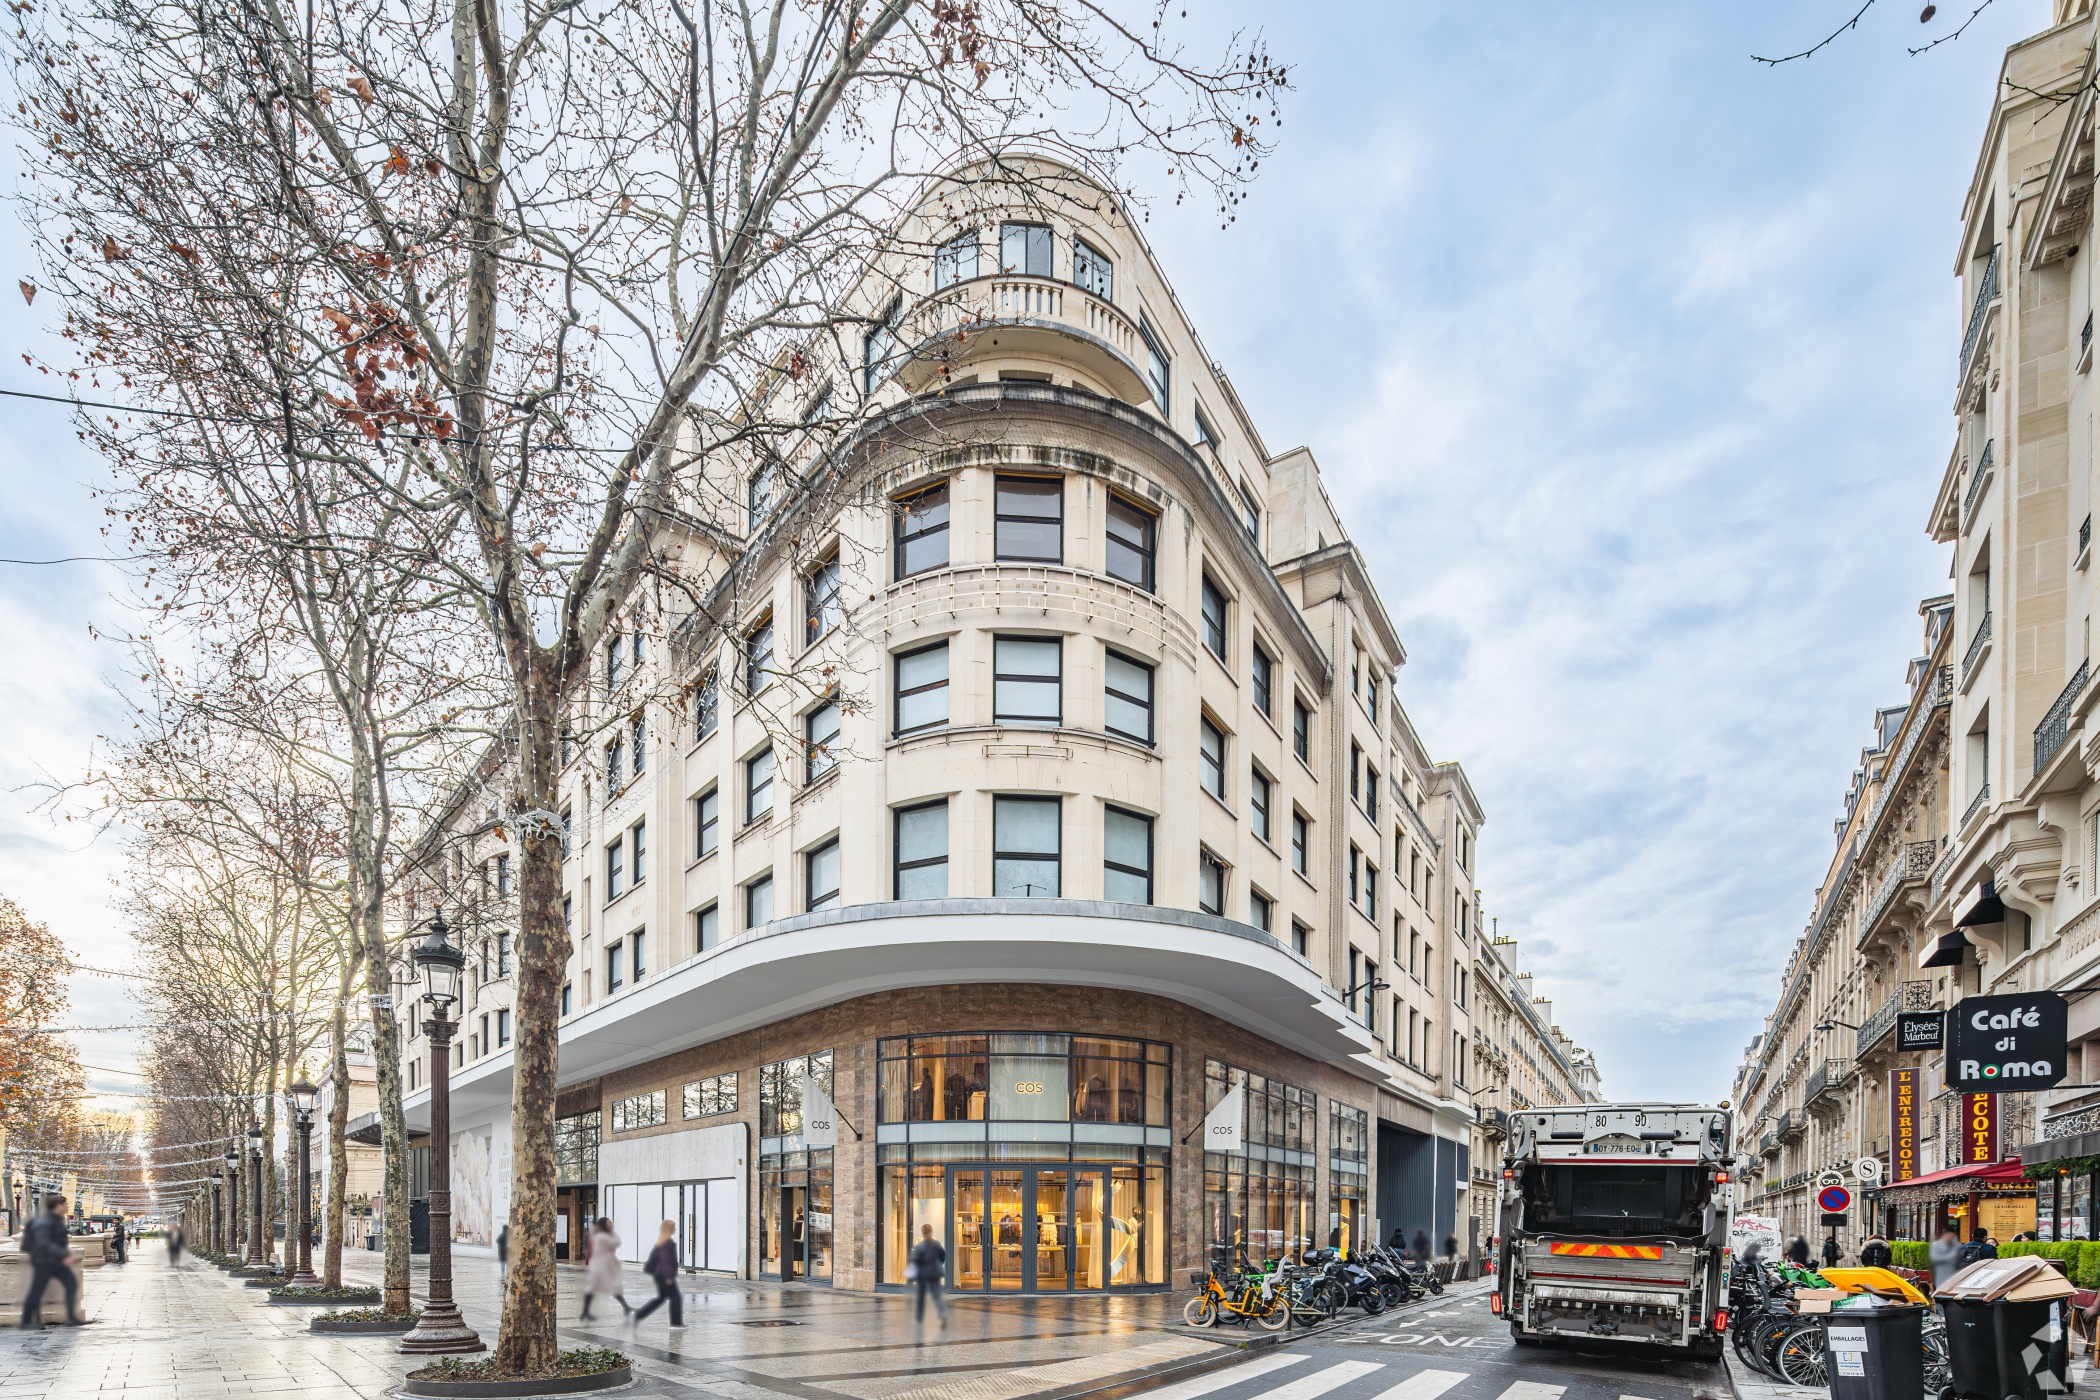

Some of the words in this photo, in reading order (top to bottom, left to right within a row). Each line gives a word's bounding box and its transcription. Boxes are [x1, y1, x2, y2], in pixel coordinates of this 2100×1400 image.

[1971, 1006, 2041, 1031] Café
[1904, 1020, 1940, 1034] Élysées
[1904, 1030, 1939, 1042] Marbeuf
[1995, 1036, 2016, 1052] di
[1960, 1059, 2052, 1080] Roma
[1016, 1082, 1043, 1093] COS
[811, 1120, 830, 1130] COS
[1595, 1115, 1607, 1127] 80
[1635, 1114, 1647, 1127] 90
[1898, 1071, 1913, 1180] L'ENTRECOTE
[1212, 1126, 1233, 1135] COS
[1334, 1332, 1511, 1349] ZONE
